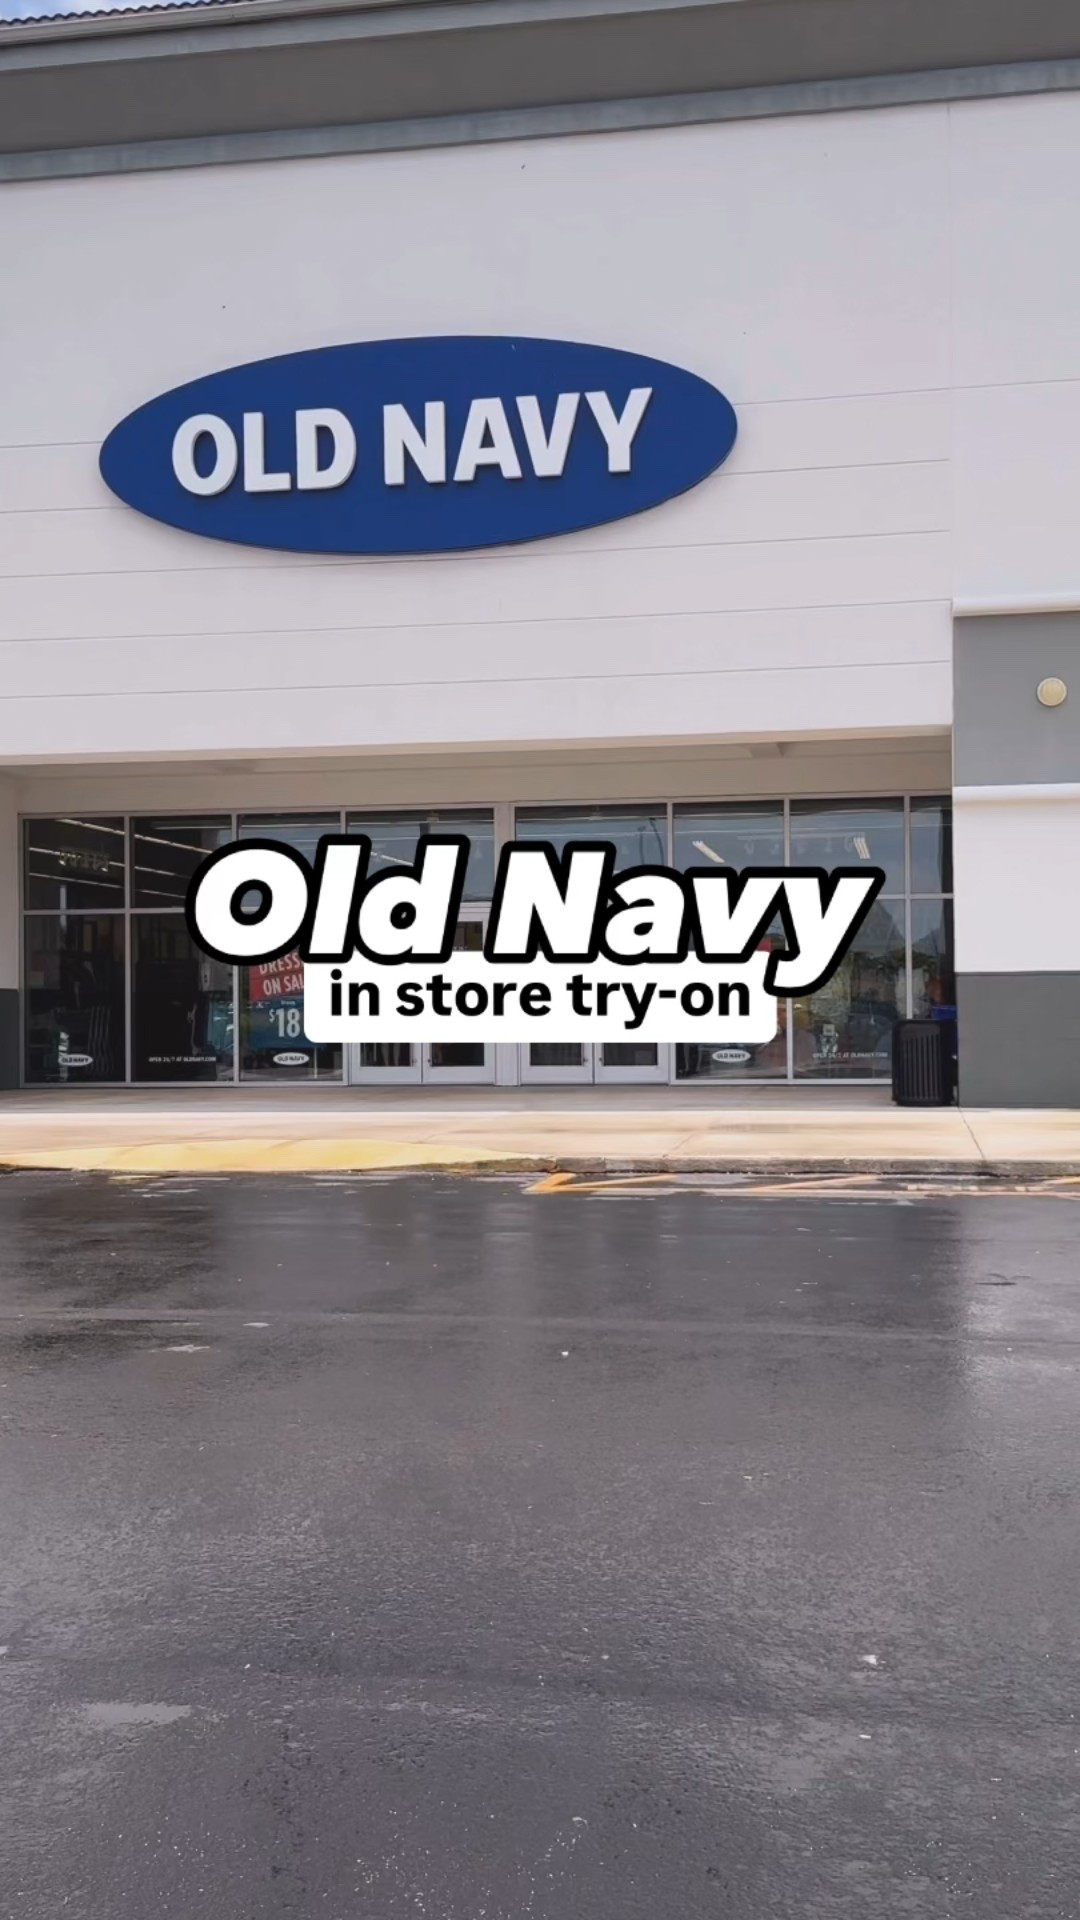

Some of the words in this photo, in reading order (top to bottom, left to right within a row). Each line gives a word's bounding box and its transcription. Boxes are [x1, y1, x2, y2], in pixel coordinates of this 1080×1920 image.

[172, 408, 356, 496] OLD
[383, 387, 653, 485] NAVY
[260, 952, 304, 974] DRESS
[263, 978, 281, 995] ON
[284, 974, 304, 993] SAL
[268, 1008, 301, 1038] $18
